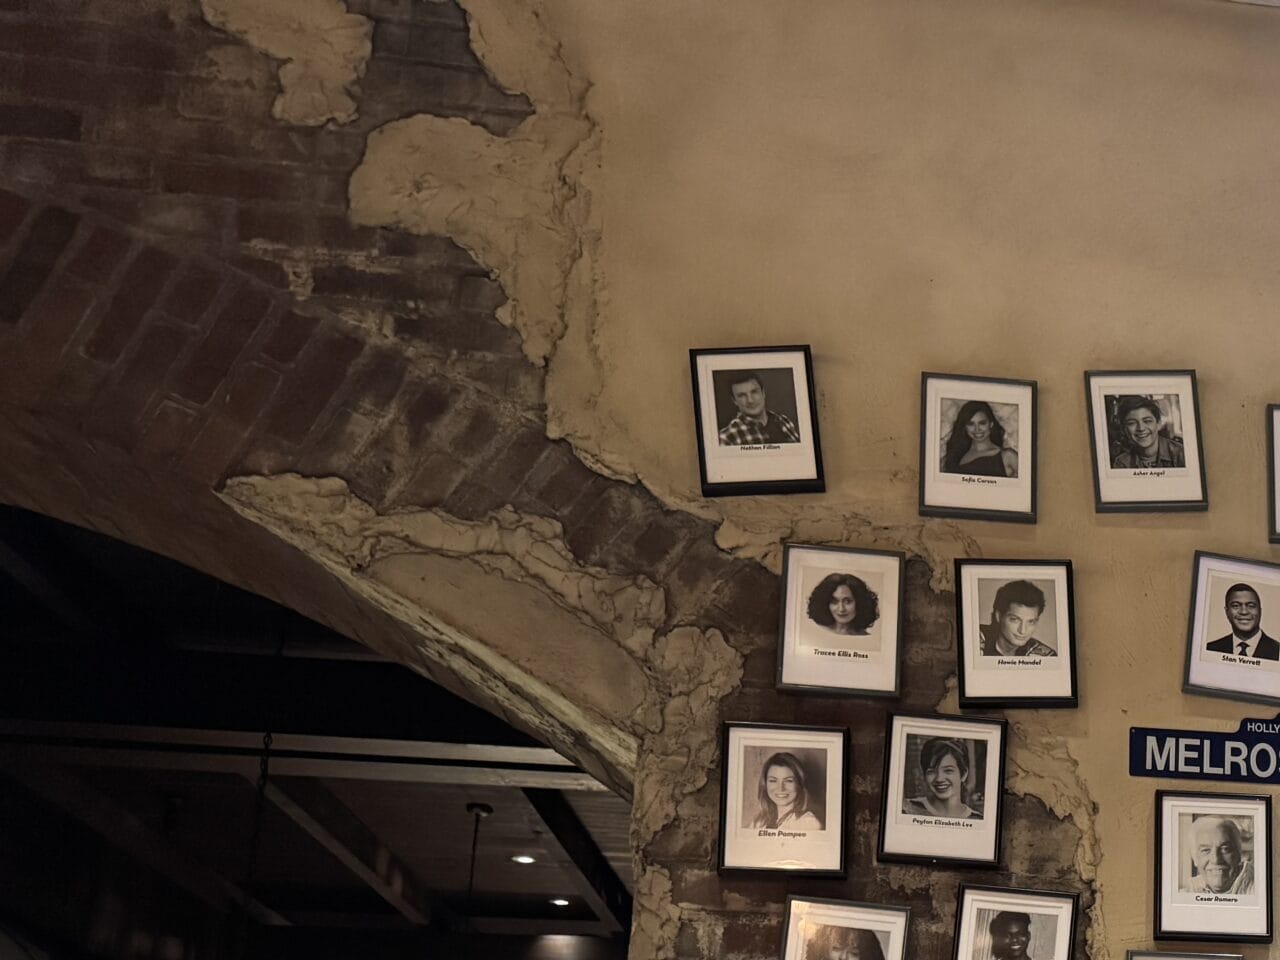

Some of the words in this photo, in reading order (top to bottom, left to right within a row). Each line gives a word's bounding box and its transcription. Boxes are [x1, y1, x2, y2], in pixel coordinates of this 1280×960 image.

[814, 649, 835, 657] Tracee
[1222, 655, 1236, 663] Stan
[1238, 657, 1261, 666] Verrett
[912, 818, 933, 826] Peyton
